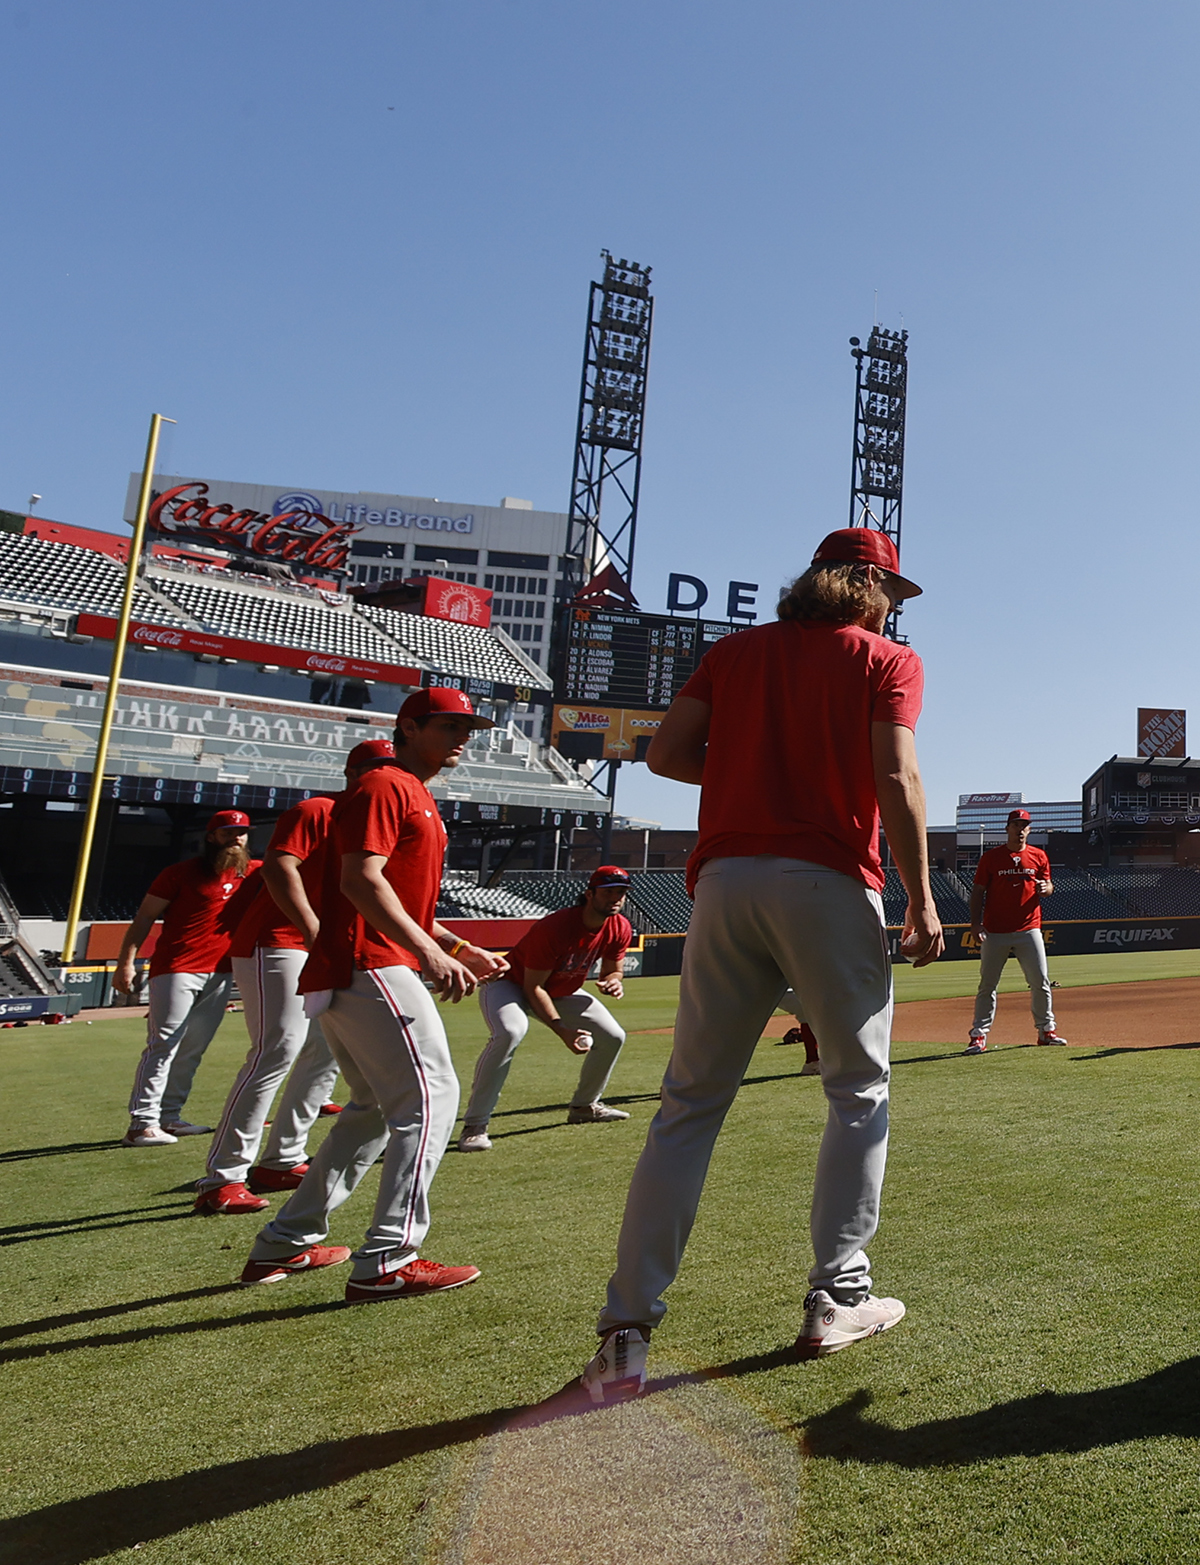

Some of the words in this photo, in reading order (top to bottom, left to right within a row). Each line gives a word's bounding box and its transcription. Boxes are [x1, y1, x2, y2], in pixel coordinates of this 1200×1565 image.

[329, 502, 474, 534] LifeBrand
[667, 572, 758, 620] DE
[589, 632, 612, 641] LINDOR
[651, 638, 659, 646] SS
[591, 624, 613, 633] NIMMO
[682, 633, 692, 641] 6-3
[570, 647, 578, 655] 20
[588, 649, 613, 658] ALONSO
[587, 658, 615, 666] ESCOBAR
[429, 674, 461, 690] 3:08
[469, 679, 491, 689] 50/50
[587, 675, 609, 683] CANHA
[469, 687, 491, 696] JACKPOT
[584, 684, 609, 692] NAQUIN
[584, 692, 600, 700] NIDO
[577, 711, 610, 723] MEGA
[1143, 714, 1163, 733] THE
[1139, 710, 1185, 757] HOME
[1157, 728, 1185, 757] DEPOT
[24, 769, 32, 780] 0
[71, 773, 76, 783] 1
[113, 776, 121, 786] 2
[156, 779, 163, 790] 0
[196, 782, 203, 792] 0
[233, 785, 240, 795] 0
[269, 788, 276, 797] 0
[303, 790, 311, 800] 0
[1152, 775, 1187, 783] CLUBHOUSE
[22, 782, 28, 792] 1
[68, 785, 76, 796] 0
[112, 788, 120, 799] 3
[154, 790, 161, 801] 0
[193, 793, 201, 804] 0
[232, 796, 237, 806] 1
[267, 798, 275, 808] 0
[454, 802, 460, 810] 0
[453, 811, 459, 820] 0
[481, 813, 498, 821] VISITS
[554, 814, 561, 826] 0
[575, 815, 582, 827] 0
[596, 817, 603, 829] 3
[1093, 928, 1175, 946] EQUIFAX
[69, 973, 92, 984] 335
